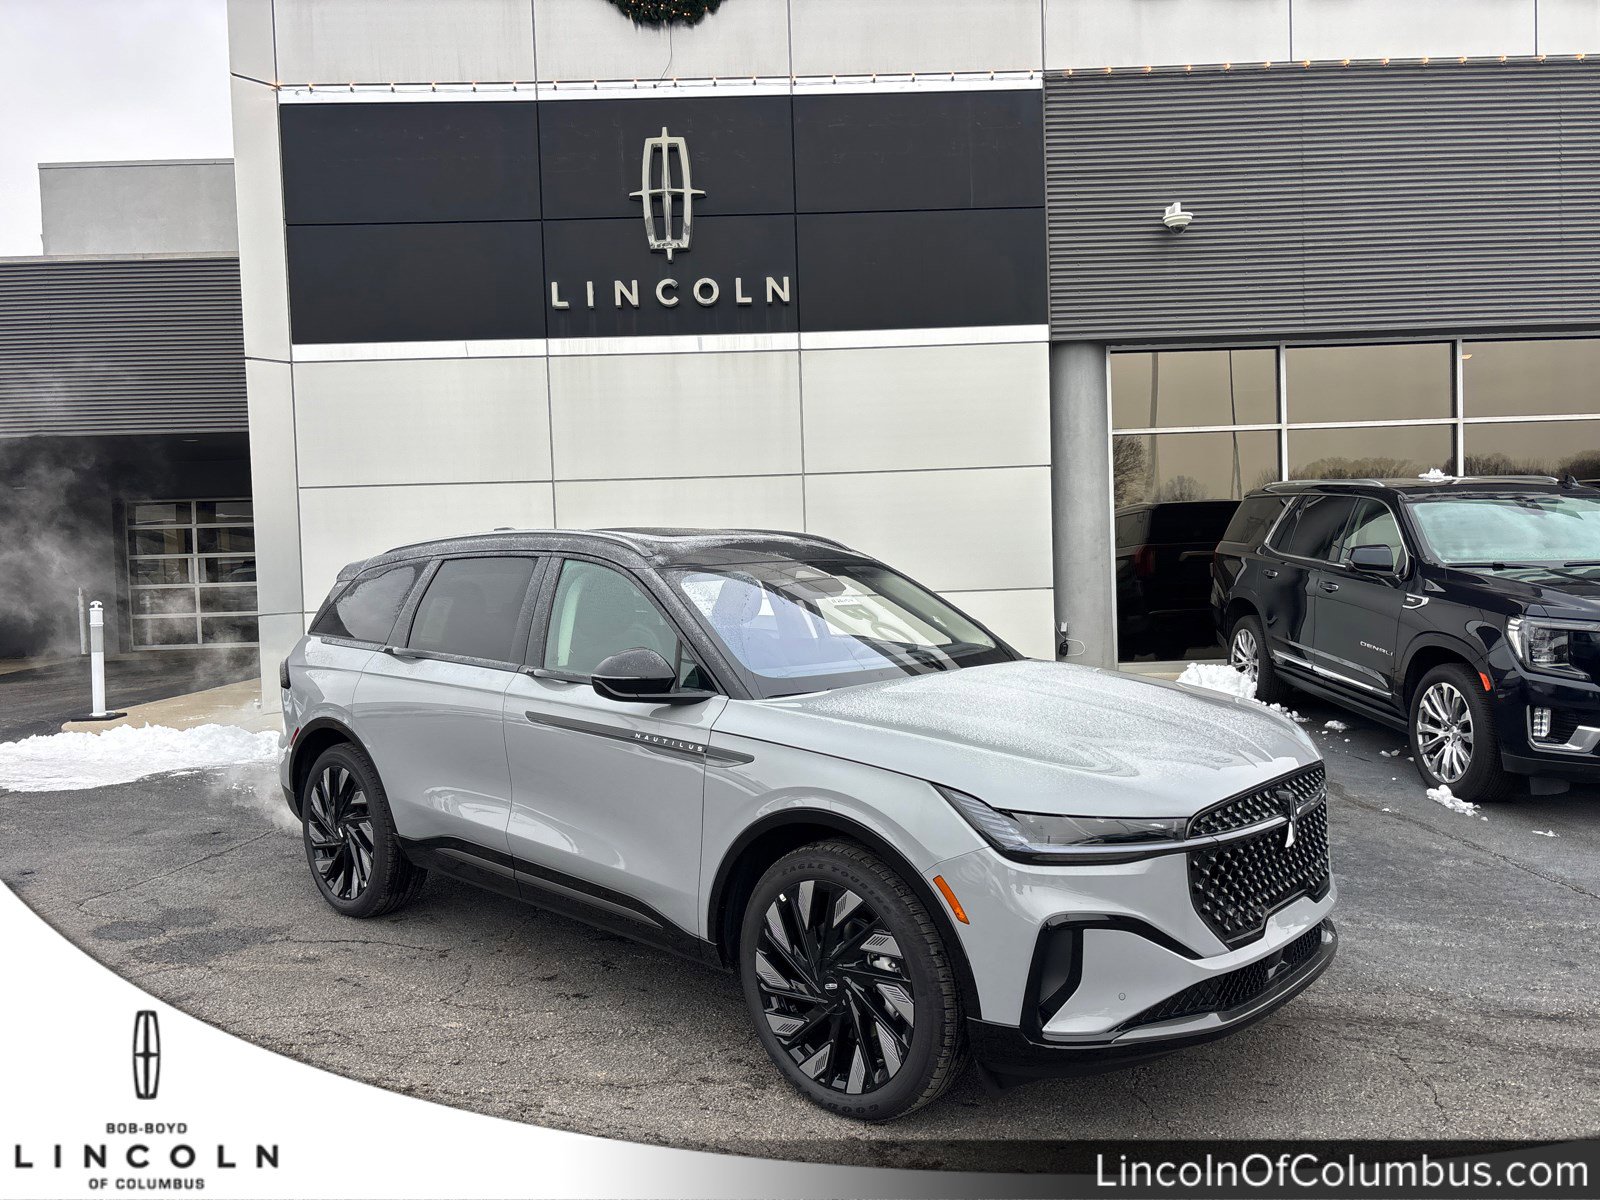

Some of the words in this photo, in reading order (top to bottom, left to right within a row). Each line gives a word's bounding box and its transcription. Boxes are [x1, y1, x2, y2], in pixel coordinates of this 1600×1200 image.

[551, 276, 791, 309] LINCOLN
[1360, 640, 1393, 657] DENALI
[634, 733, 703, 752] NAUTILUS
